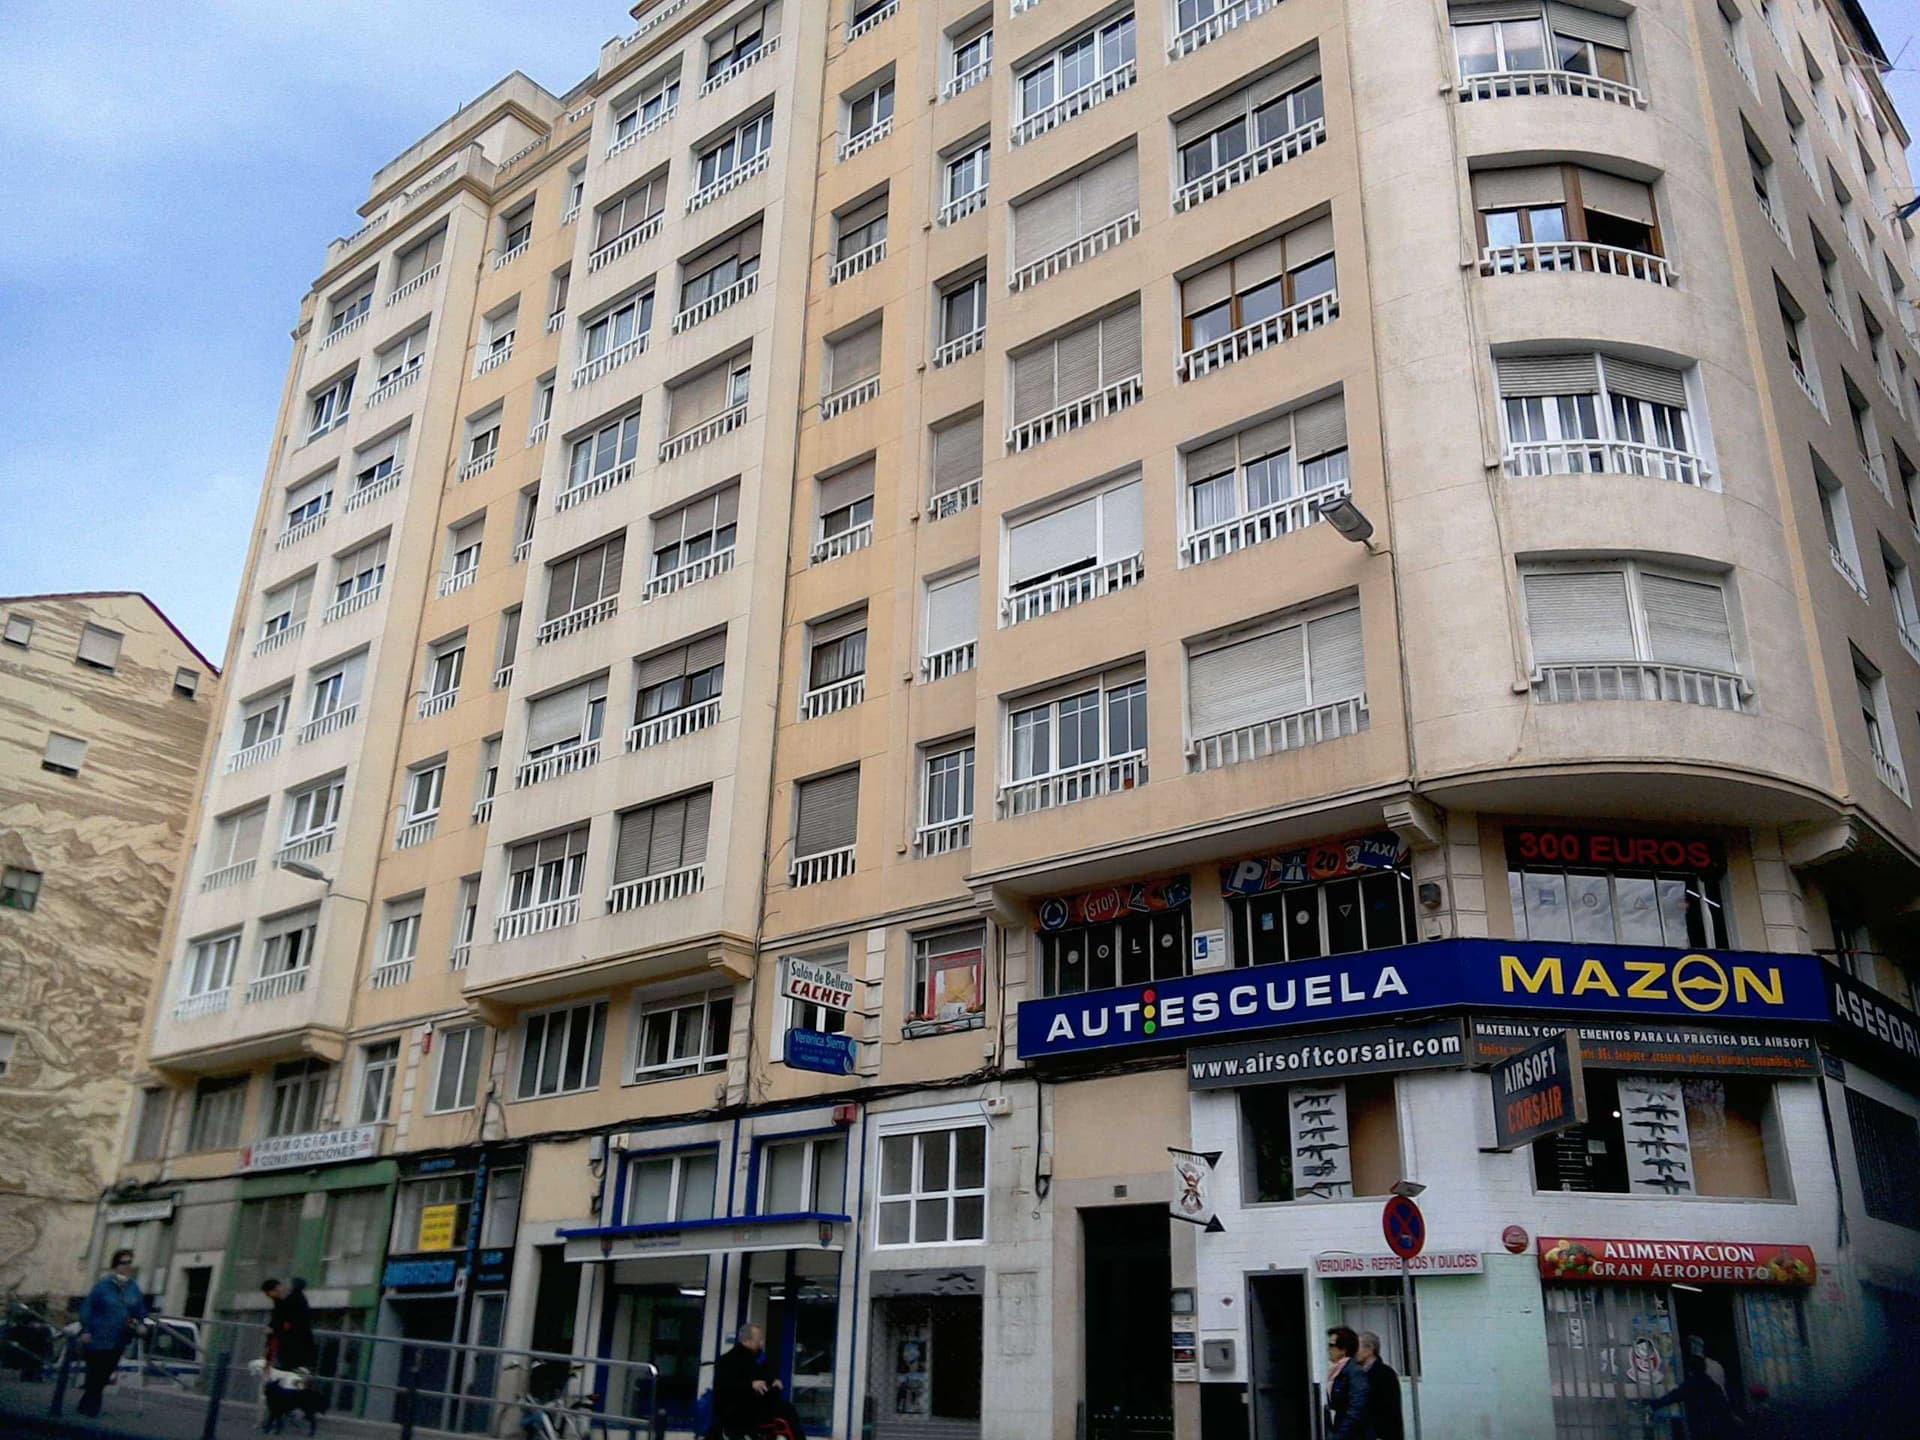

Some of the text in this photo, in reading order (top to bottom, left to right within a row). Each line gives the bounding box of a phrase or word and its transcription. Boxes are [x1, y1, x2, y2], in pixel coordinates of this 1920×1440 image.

[1315, 851, 1338, 870] 20
[1362, 840, 1396, 858] TAXI
[1519, 832, 1712, 868] 300 EUROS
[1232, 860, 1262, 889] P
[1088, 892, 1115, 916] STOP
[1194, 938, 1206, 958] L
[814, 968, 824, 984] de
[825, 971, 853, 993] Belleza
[1500, 954, 1785, 1012] MAZON
[790, 979, 851, 1008] CACHET
[1476, 1023, 1531, 1037] MATERIAL
[1532, 1026, 1540, 1037] Y
[1542, 1026, 1631, 1041] COEMENTOS
[1633, 1031, 1663, 1042] PARA
[1666, 1033, 1681, 1044] LA
[1741, 1035, 1761, 1047] DEL
[1765, 1036, 1810, 1049] AIRSOFT
[1192, 1034, 1460, 1079] www.airsoftcorsair.com
[1504, 1046, 1557, 1095] AIRSOFT
[1507, 1085, 1564, 1135] CORSAIR
[255, 1130, 360, 1151] PROMOCIONES
[1316, 1258, 1364, 1273] VERDURAS
[1371, 1256, 1428, 1272] REFRECOS
[1426, 1256, 1435, 1269] Y
[1438, 1254, 1478, 1269] DULCES
[1604, 1242, 1756, 1263] ALIMENTACION
[1592, 1261, 1769, 1281] GRAN AEROPUERTO
